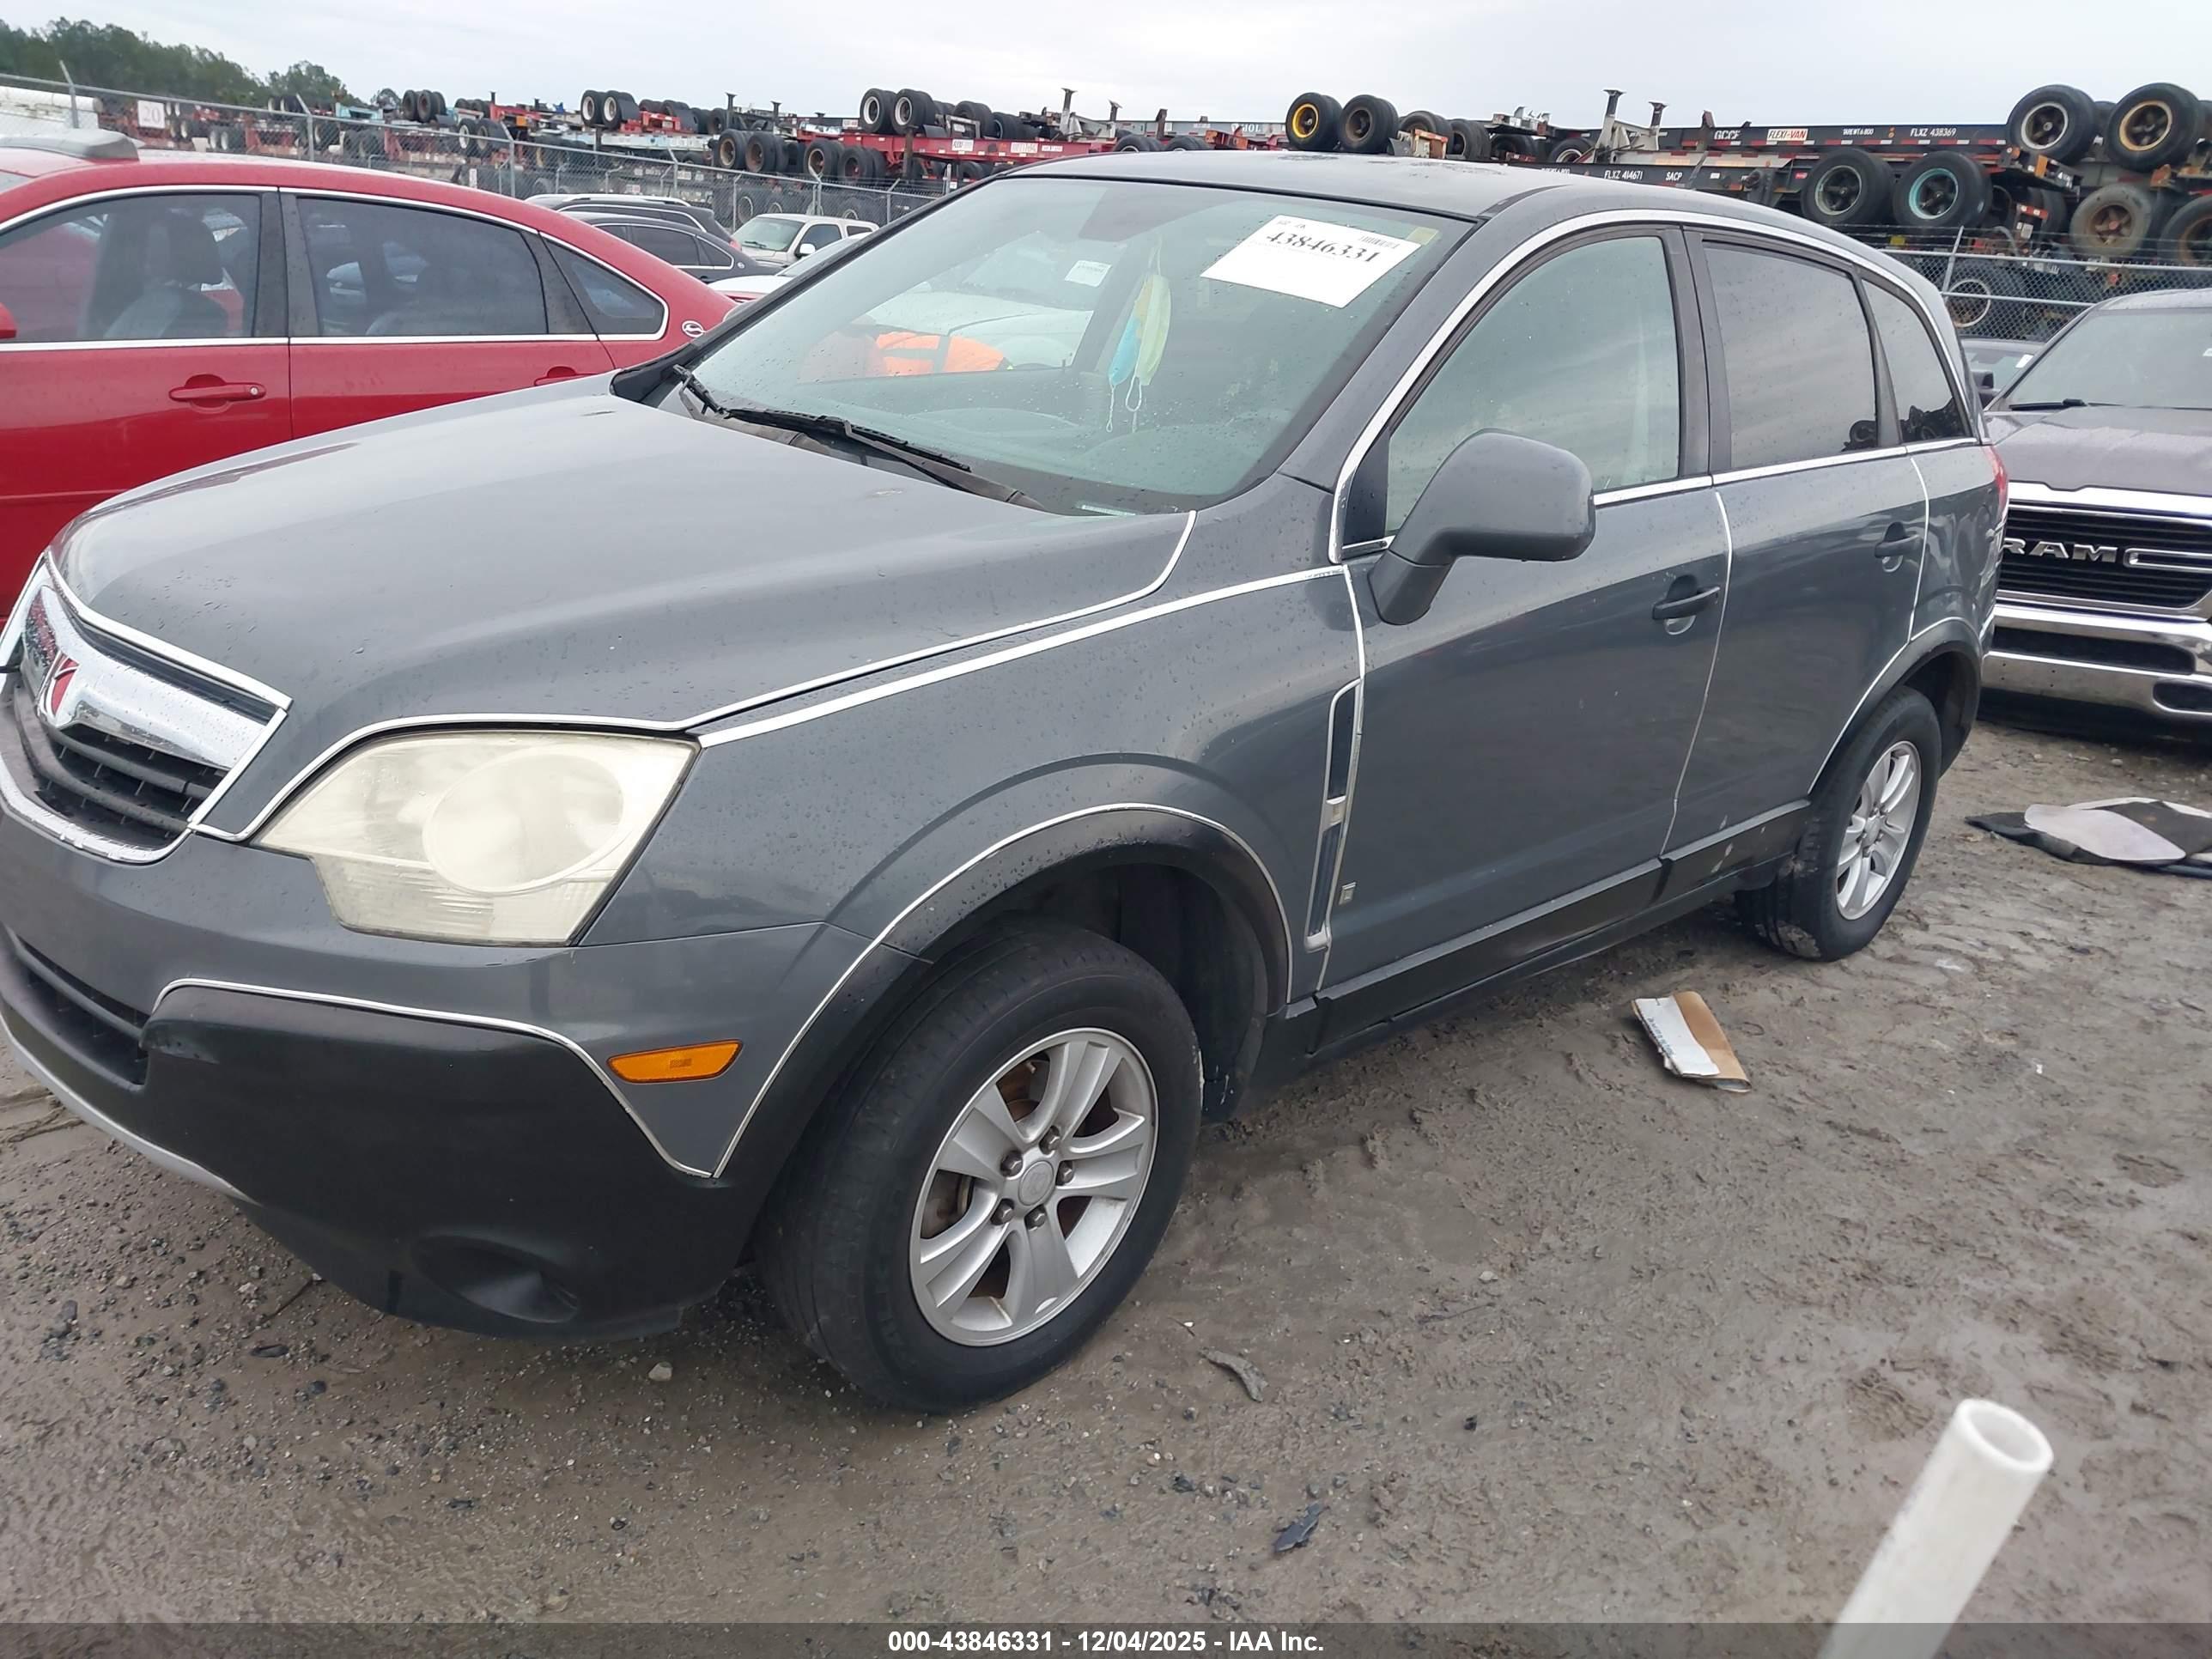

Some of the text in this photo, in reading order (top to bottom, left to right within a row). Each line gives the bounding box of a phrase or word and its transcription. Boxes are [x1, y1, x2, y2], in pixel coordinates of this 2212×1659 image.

[143, 106, 161, 124] 20
[1910, 127, 1957, 137] FLXZ 438369
[1604, 170, 1621, 179] FLXZ
[1665, 171, 1683, 182] SACP
[1266, 232, 1381, 262] 43846331
[2002, 538, 2118, 563] RAM
